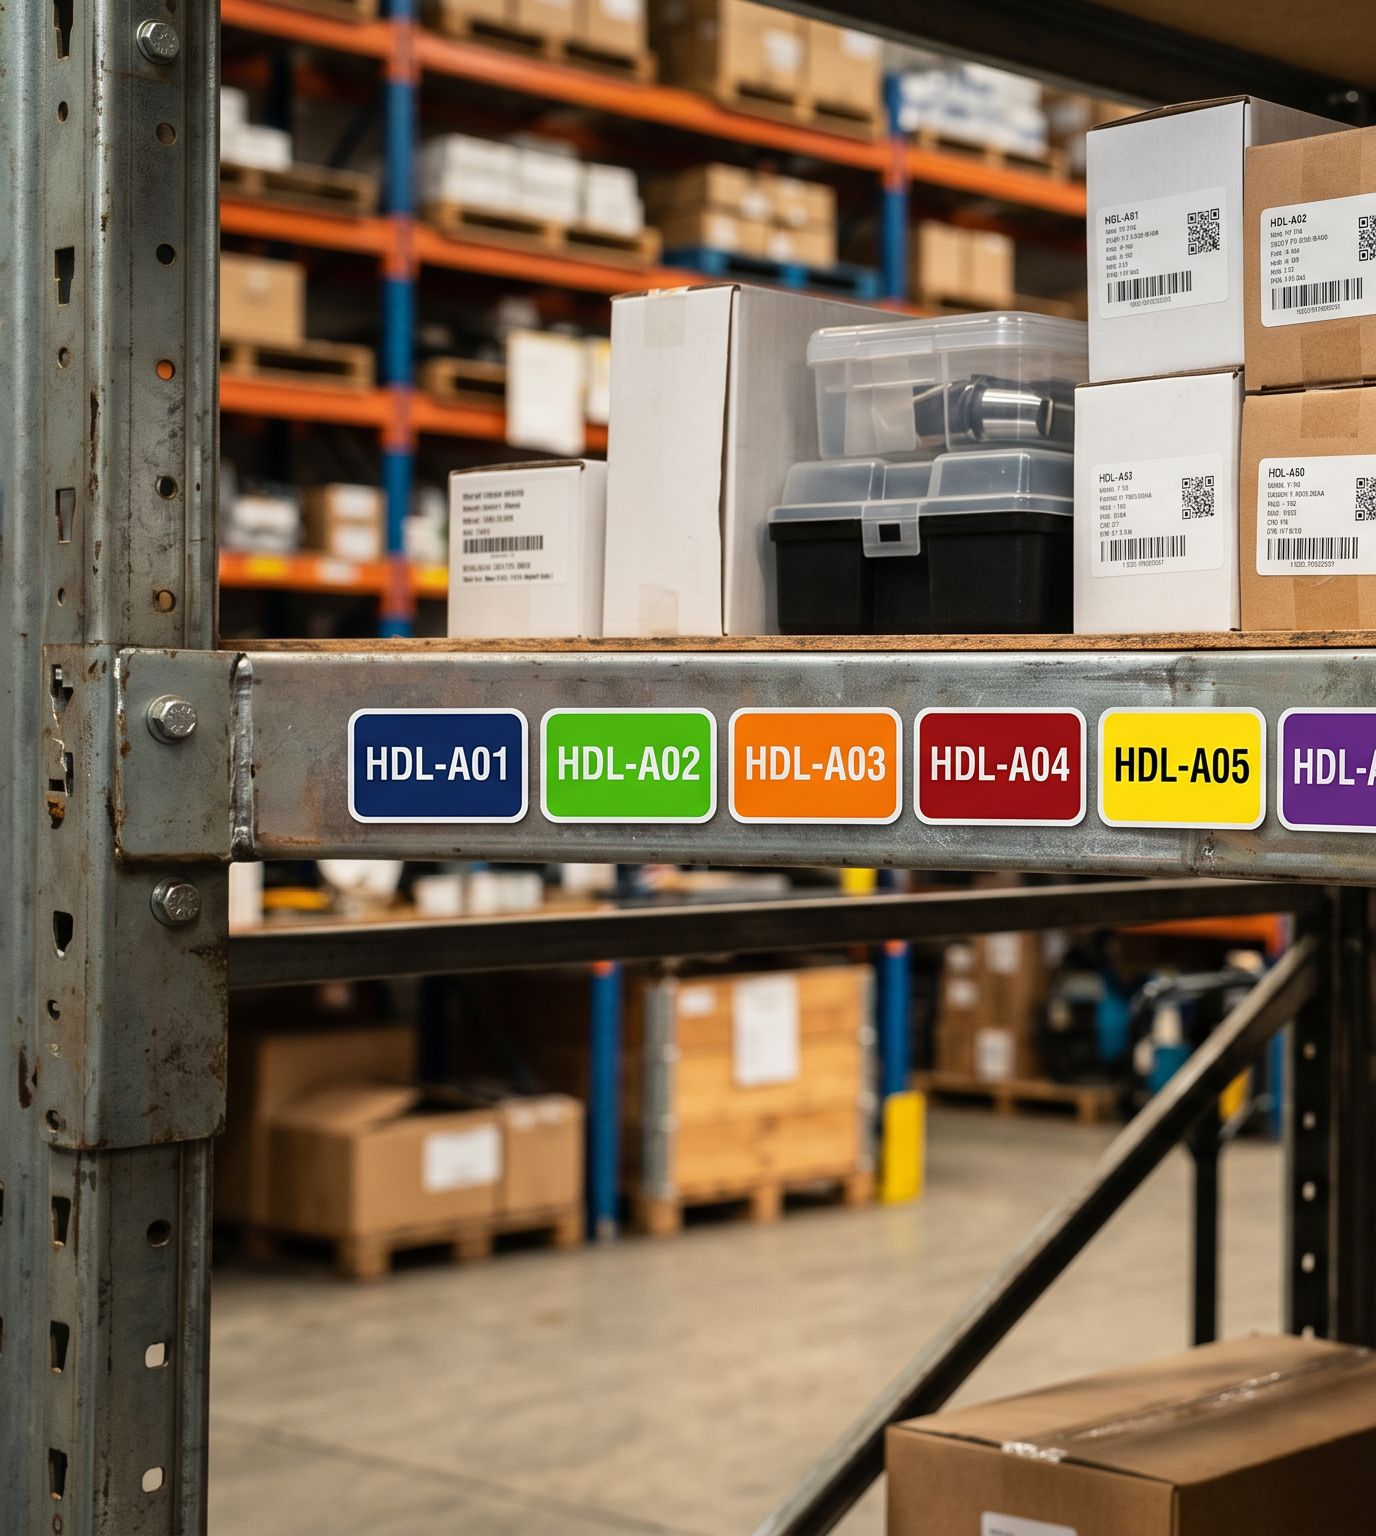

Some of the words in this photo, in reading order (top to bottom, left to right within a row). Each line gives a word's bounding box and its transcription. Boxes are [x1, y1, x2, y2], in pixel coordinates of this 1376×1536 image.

[1270, 214, 1307, 227] HDL-A02
[367, 747, 506, 780] HDL-A01
[559, 746, 699, 780] HDL-A02
[747, 746, 885, 781] HDL-A03
[932, 747, 1069, 781] HDL-A04
[1116, 747, 1249, 783] HDL-A05
